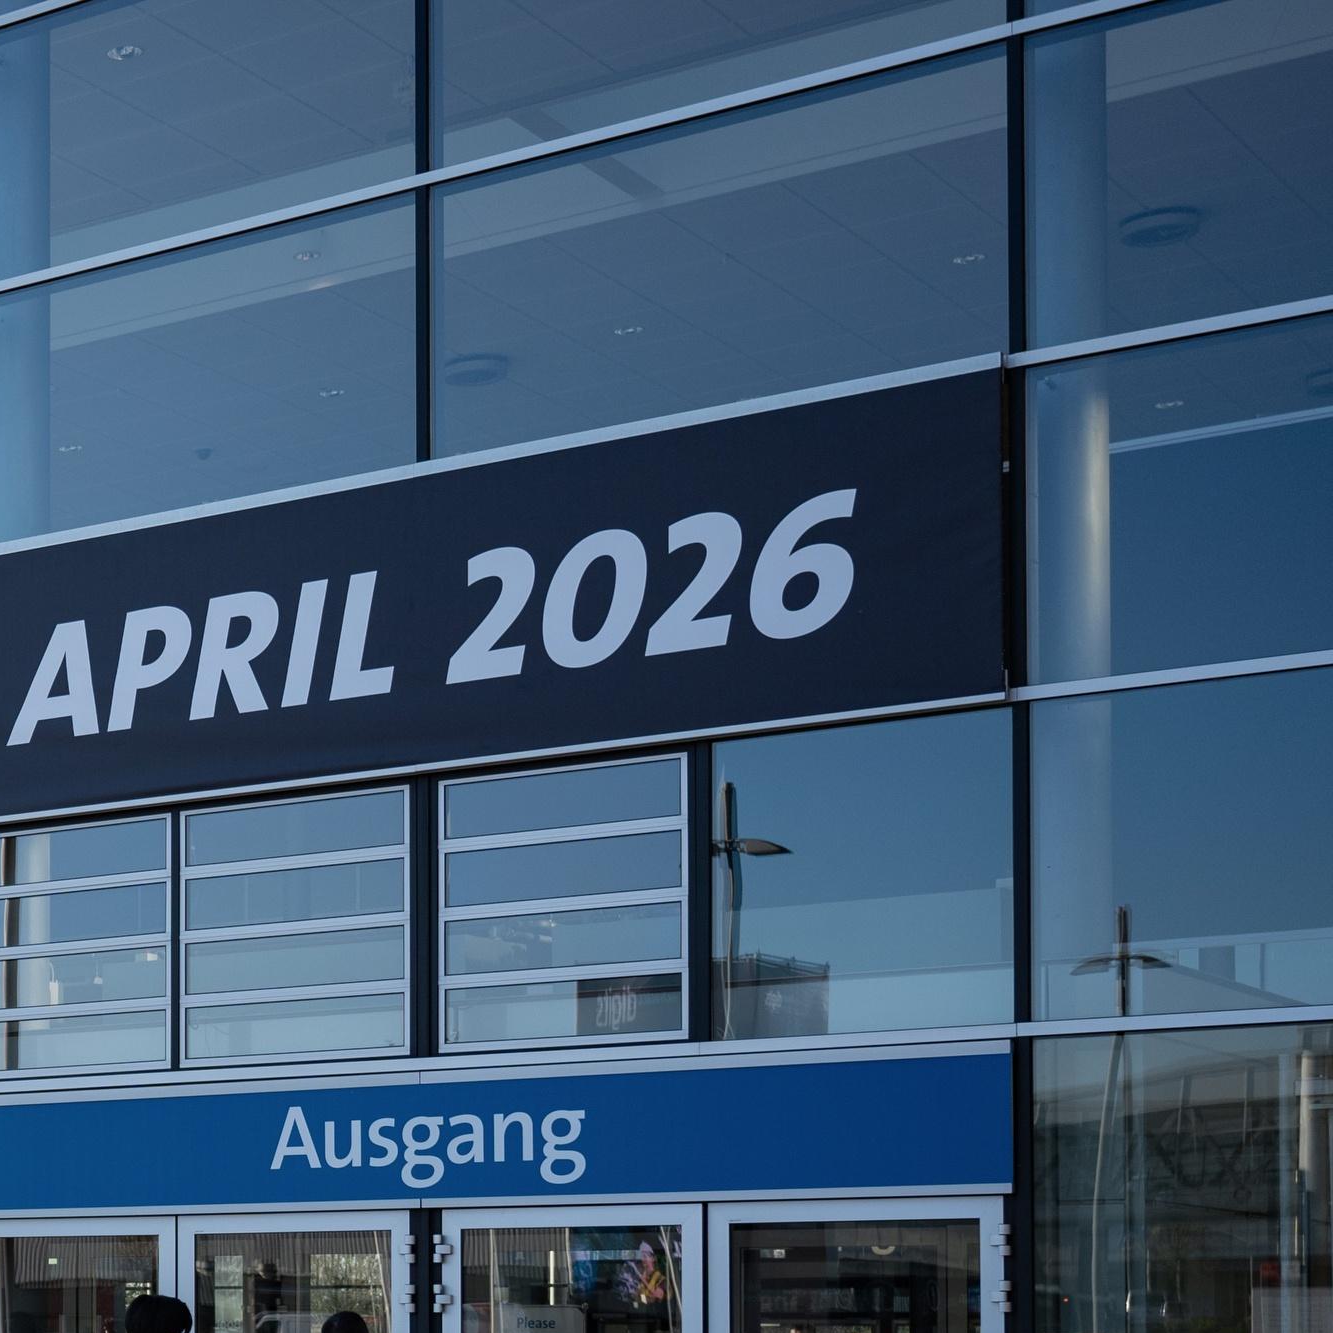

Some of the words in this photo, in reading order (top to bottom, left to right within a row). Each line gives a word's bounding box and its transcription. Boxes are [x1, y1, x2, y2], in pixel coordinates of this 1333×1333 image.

[6, 571, 394, 746] APRIL
[446, 489, 856, 684] 2026
[271, 1106, 587, 1188] Ausgang
[517, 1317, 556, 1329] Please
